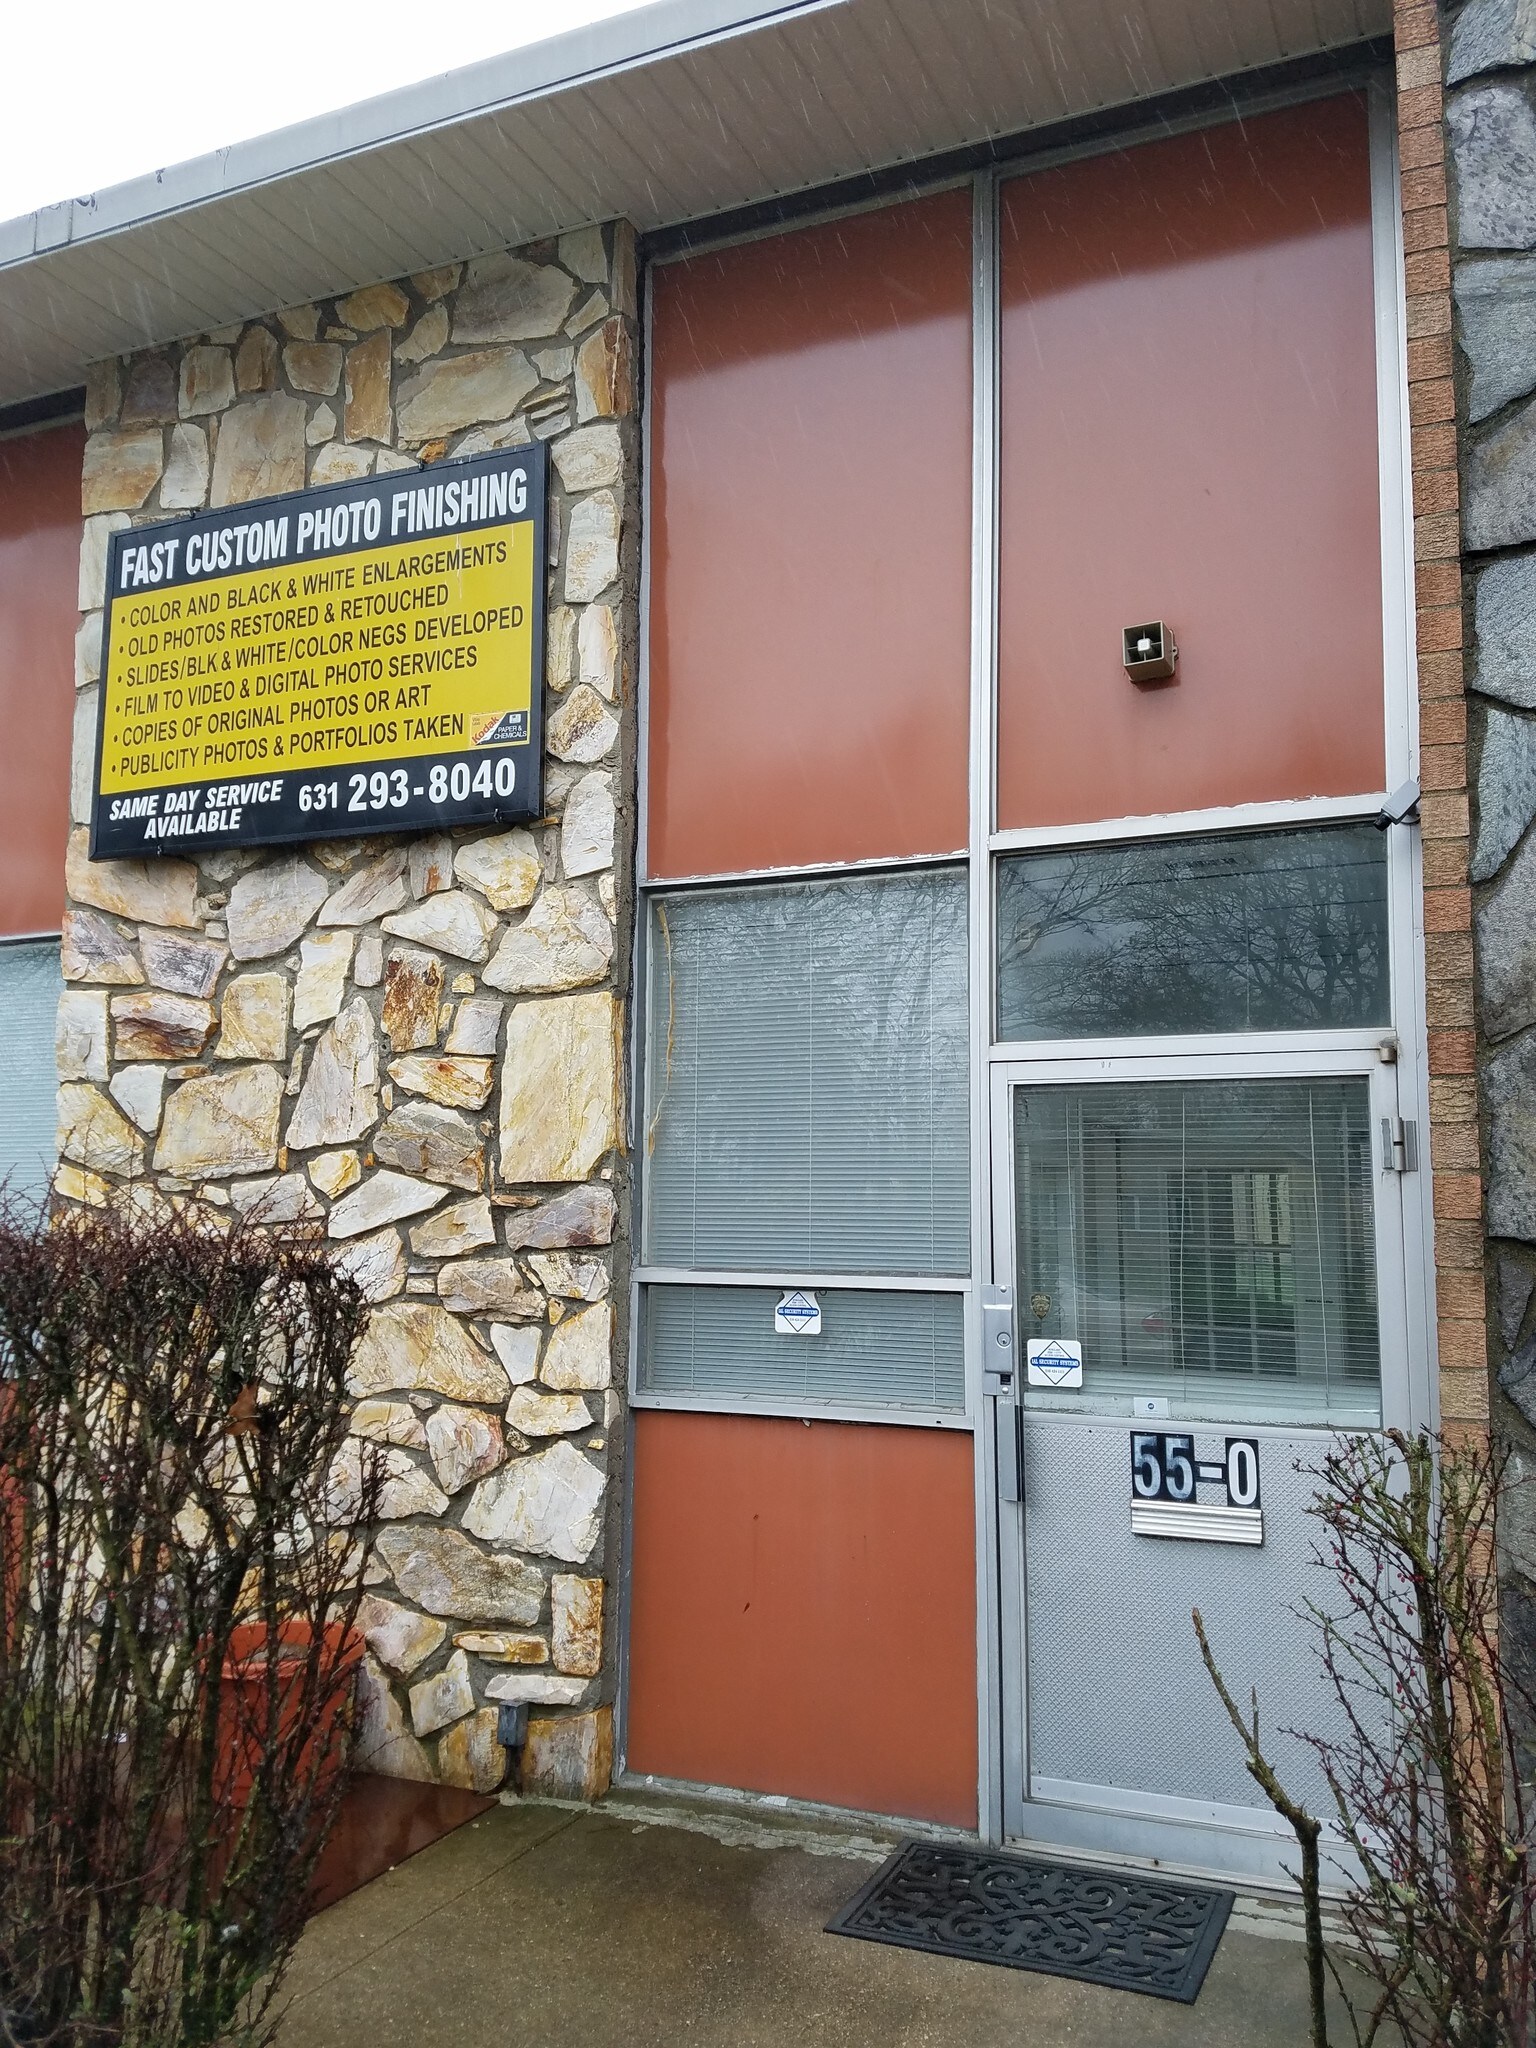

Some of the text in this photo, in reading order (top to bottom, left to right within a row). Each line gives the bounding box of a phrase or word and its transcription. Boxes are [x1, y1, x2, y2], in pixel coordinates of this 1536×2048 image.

[120, 467, 528, 589] FAST CUSTOM PHOTO FINISHING
[130, 540, 507, 628] COLOR AND BLACK & WHITE ENLARGEMENTS
[126, 652, 218, 688] SLIDES/BLK
[221, 650, 231, 671] &
[359, 622, 407, 650] NEGS
[414, 605, 524, 642] DEVELOPED
[128, 583, 449, 657] OLD PHOTOS RESTORED & RETOUCHED
[124, 645, 477, 717] FILM TO VIDEO & DIGITAL PHOTO SERVICES
[120, 712, 464, 778] PUBLICITY PHOTOS & PORTFOLIOS TAKEN
[122, 684, 431, 747] COPIES OF ORIGINAL PHOTOS OR ART
[471, 716, 499, 743] Kodak
[493, 730, 527, 740] CHEMICALS
[498, 725, 517, 733] PAPER
[109, 779, 284, 821] SAME DAY SERVICE
[298, 757, 516, 812] 631 293-8040
[143, 808, 242, 840] AVAILABLE
[1134, 1435, 1258, 1505] 55-0
